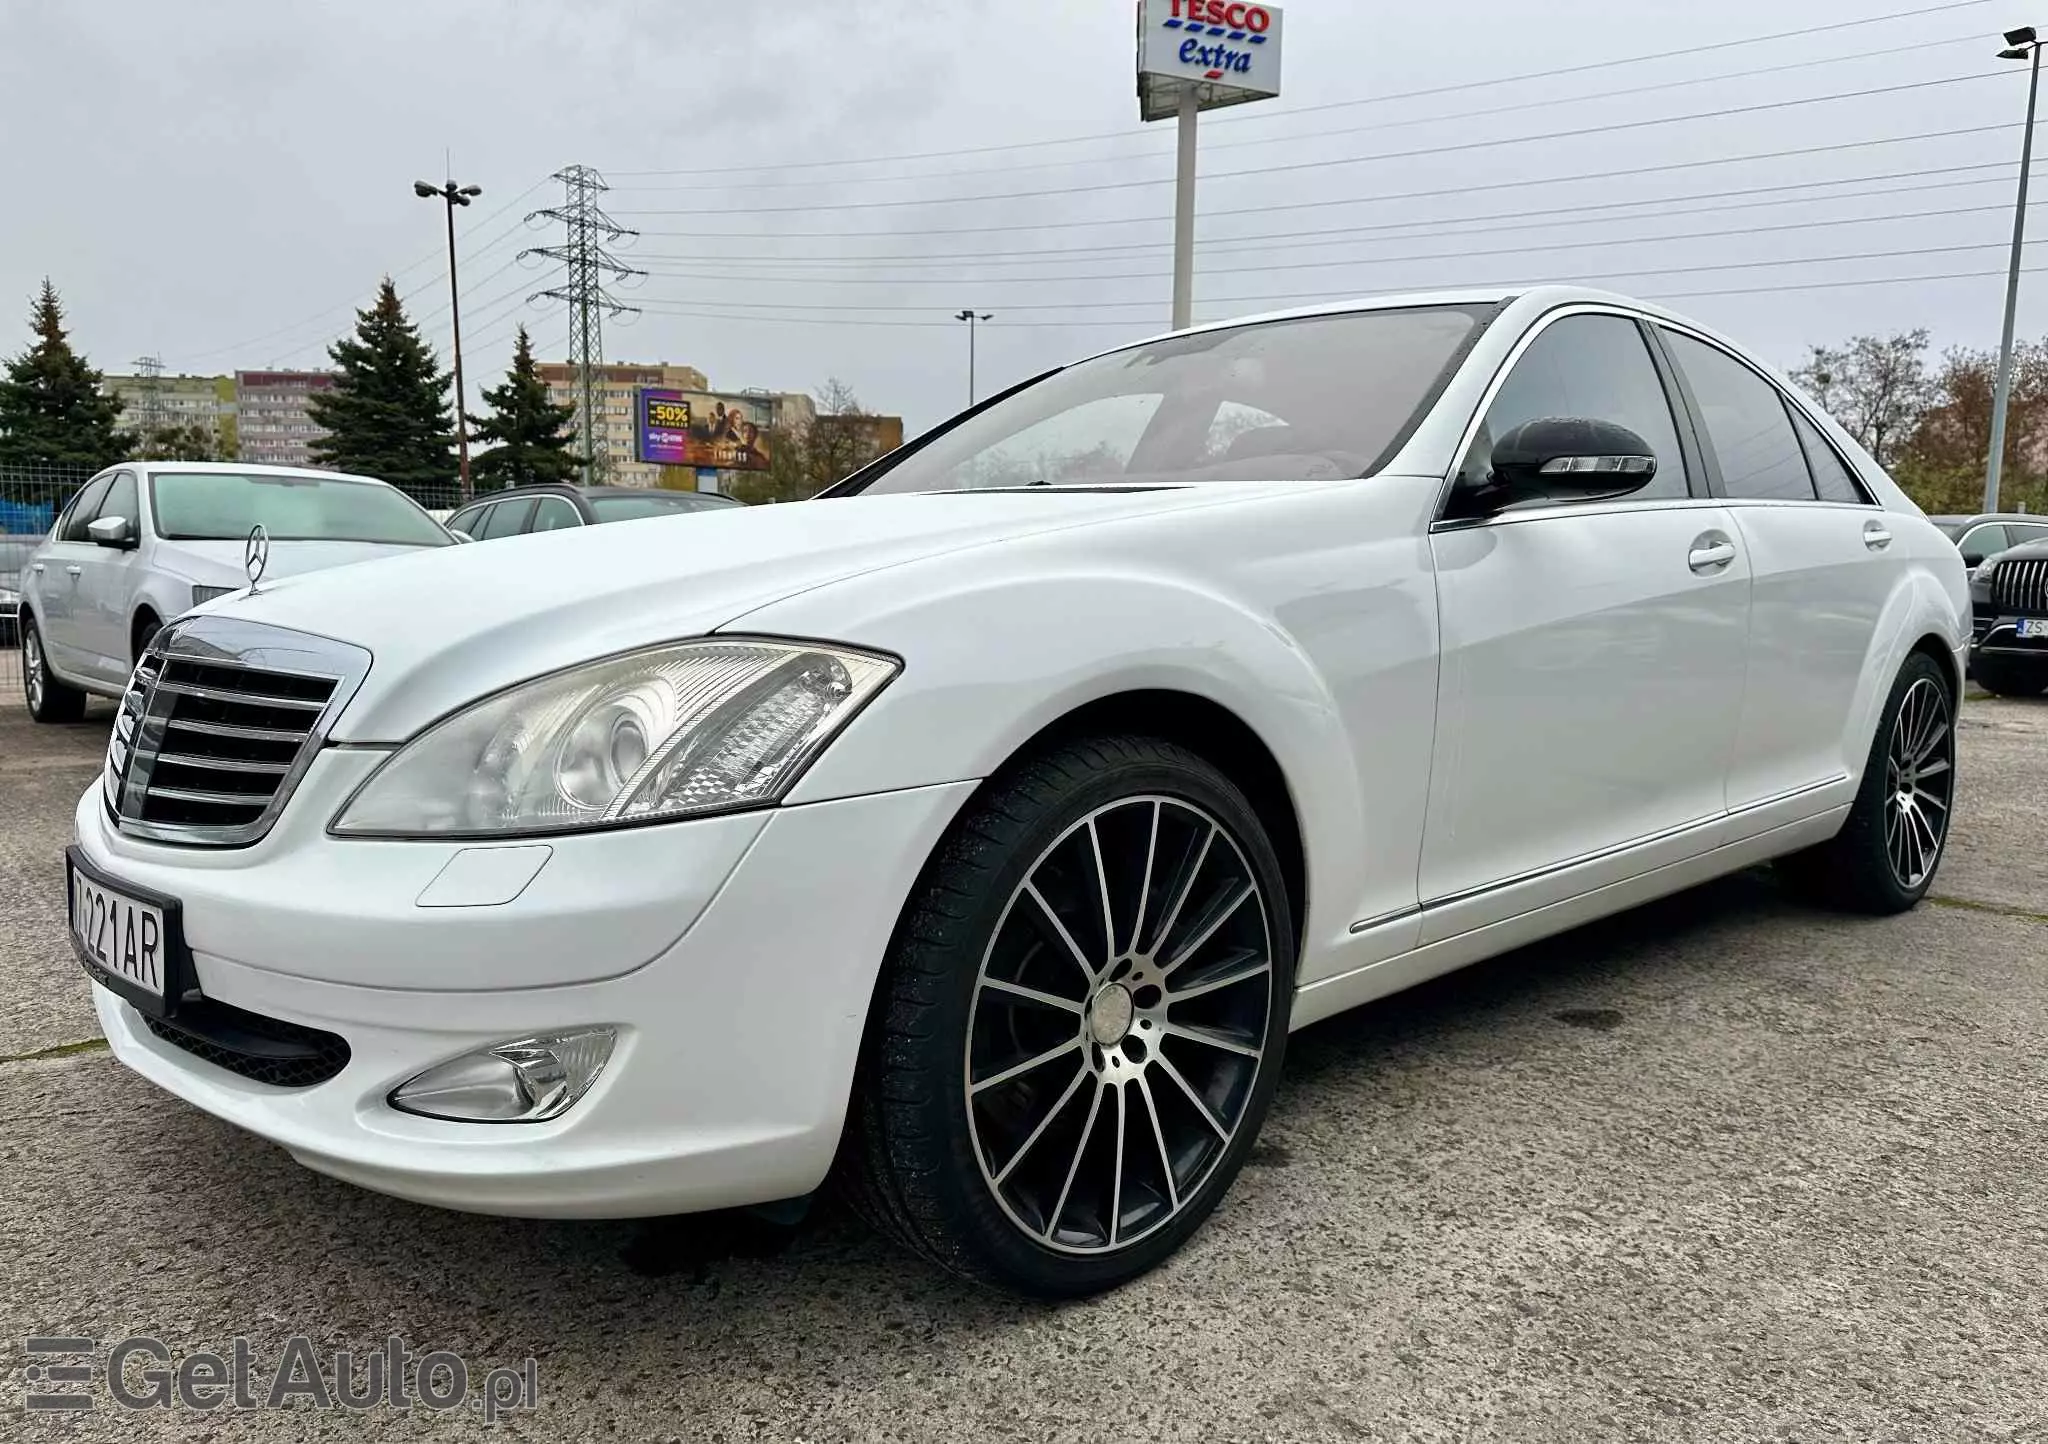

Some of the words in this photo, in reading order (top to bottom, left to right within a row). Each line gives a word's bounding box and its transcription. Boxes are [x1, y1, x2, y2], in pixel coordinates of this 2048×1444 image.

[1179, 38, 1252, 72] extra
[649, 406, 688, 421] -50%
[2026, 620, 2042, 634] ZS
